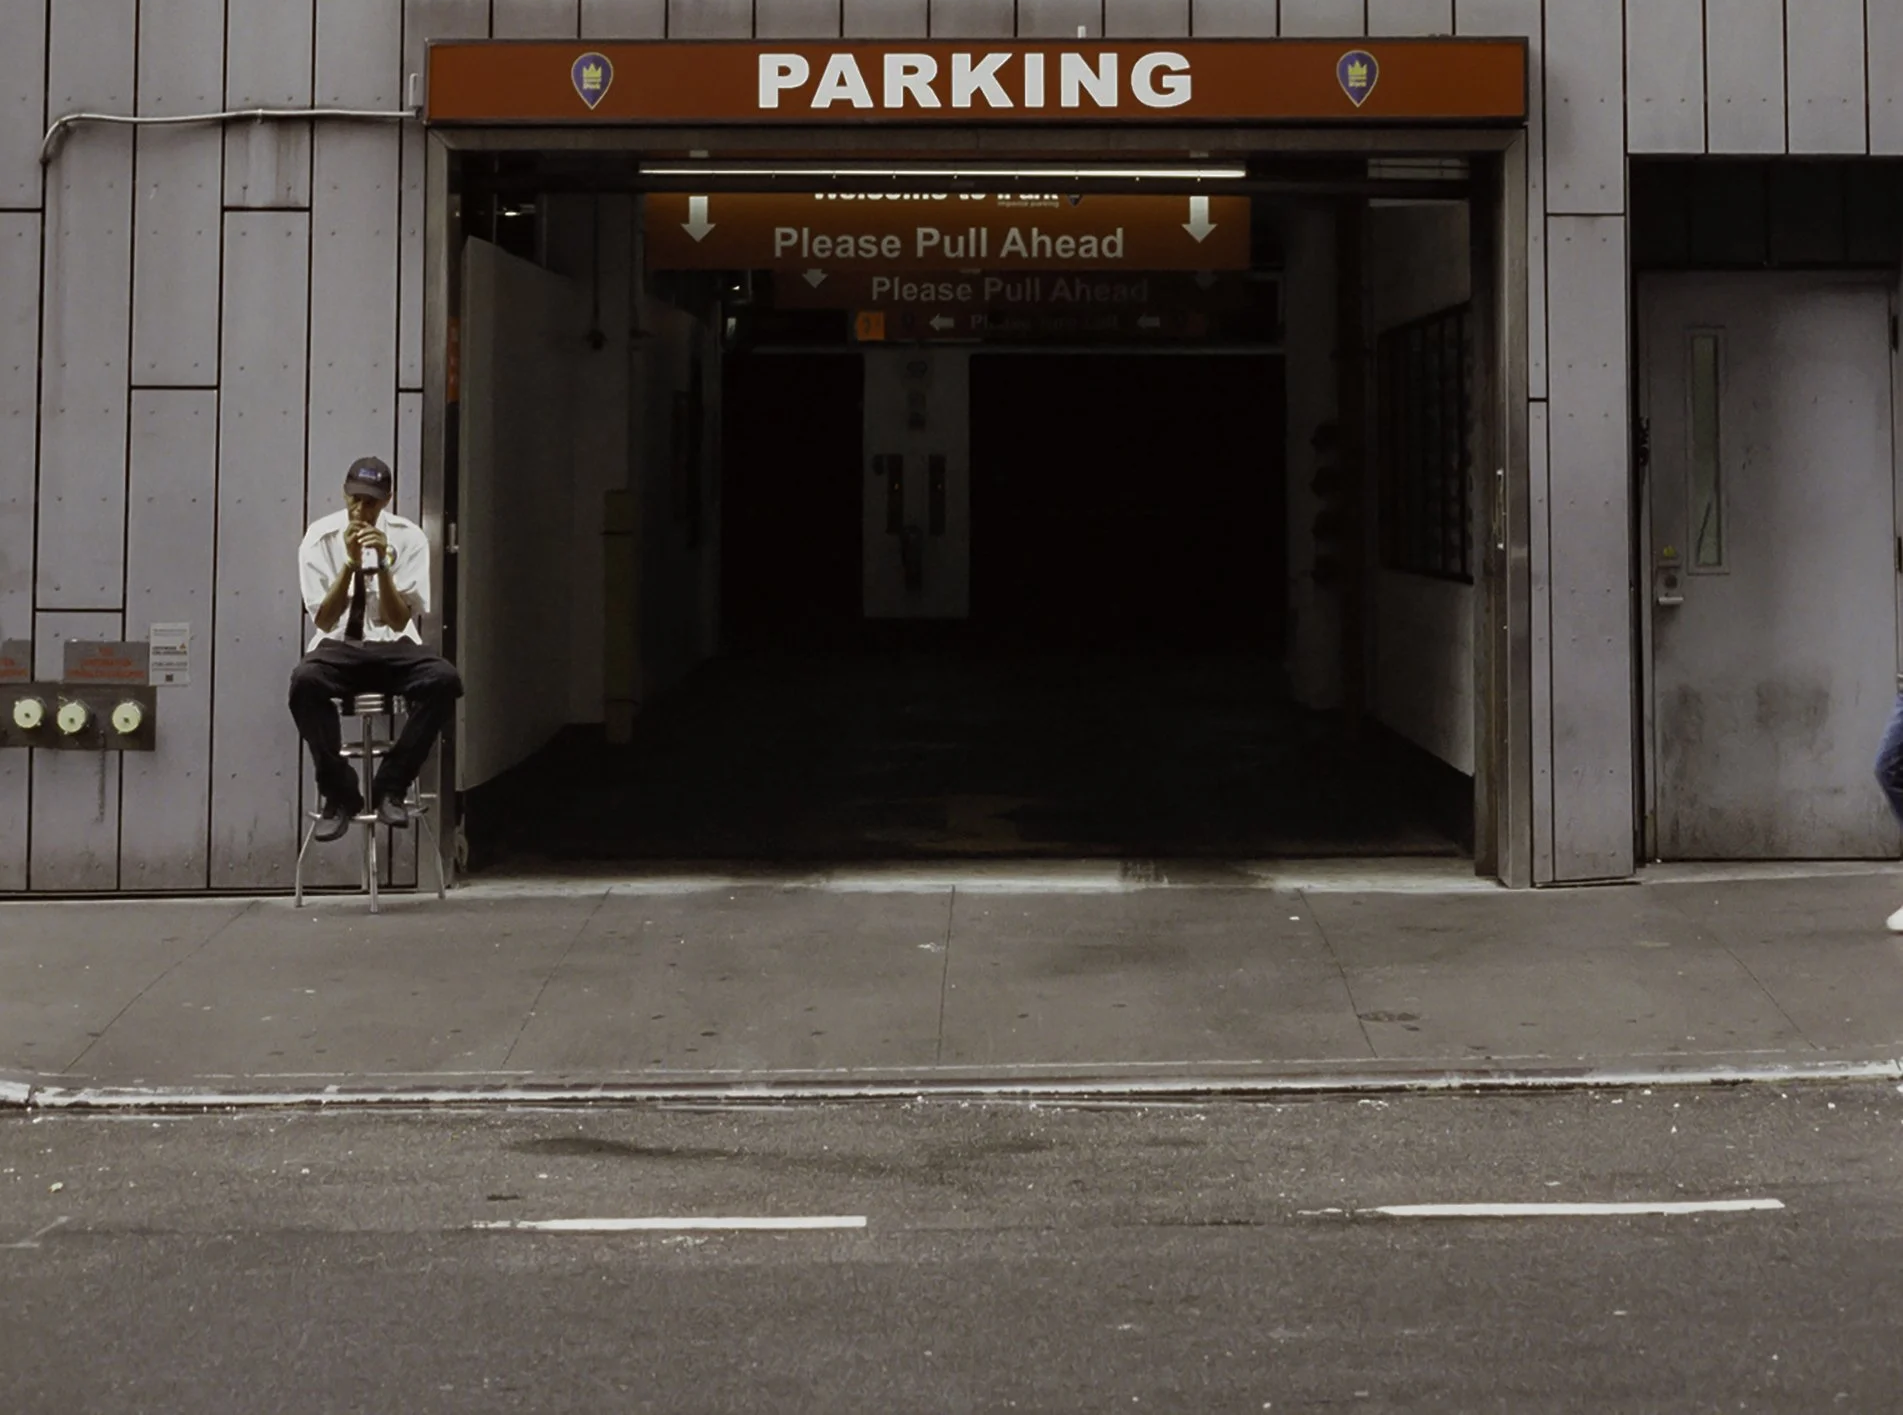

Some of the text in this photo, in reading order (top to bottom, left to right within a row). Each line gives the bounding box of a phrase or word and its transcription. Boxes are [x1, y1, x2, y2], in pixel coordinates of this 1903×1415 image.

[758, 51, 1193, 109] PARKING
[774, 226, 1125, 259] Please Pull Ahead
[871, 276, 1149, 302] Please Pull Ahead
